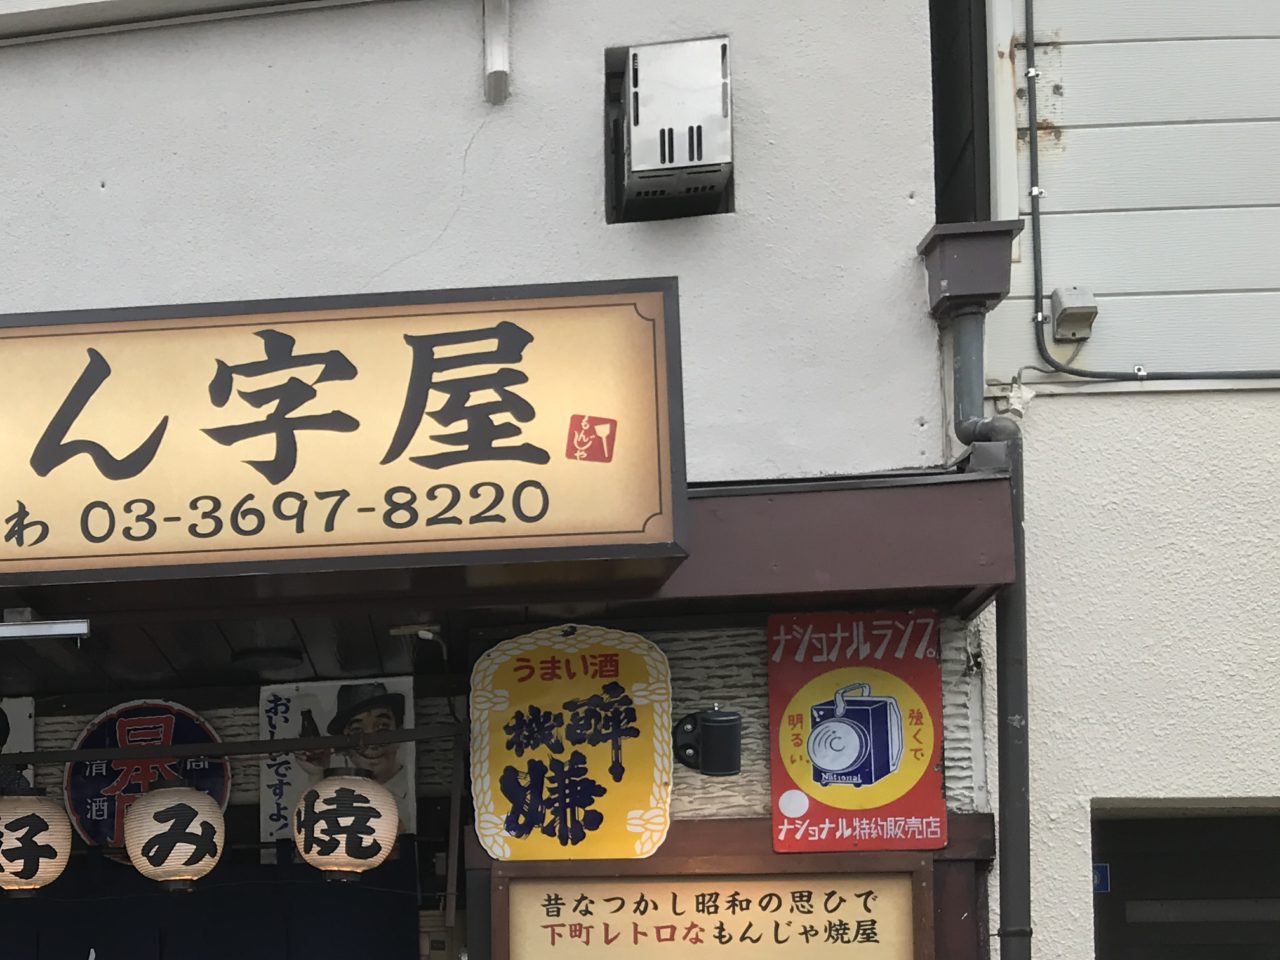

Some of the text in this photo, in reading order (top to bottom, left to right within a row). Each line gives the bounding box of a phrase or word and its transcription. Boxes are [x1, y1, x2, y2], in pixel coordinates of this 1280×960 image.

[79, 480, 550, 544] 03-3697-8220
[771, 618, 936, 664] ナショナルランプ
[513, 653, 621, 685] うまい酒
[821, 773, 862, 783] National
[140, 802, 218, 866] み
[295, 786, 382, 860] 焼
[778, 817, 941, 841] ナショナル特約販売店
[540, 889, 878, 918] 昔なつかし昭和の思ひで
